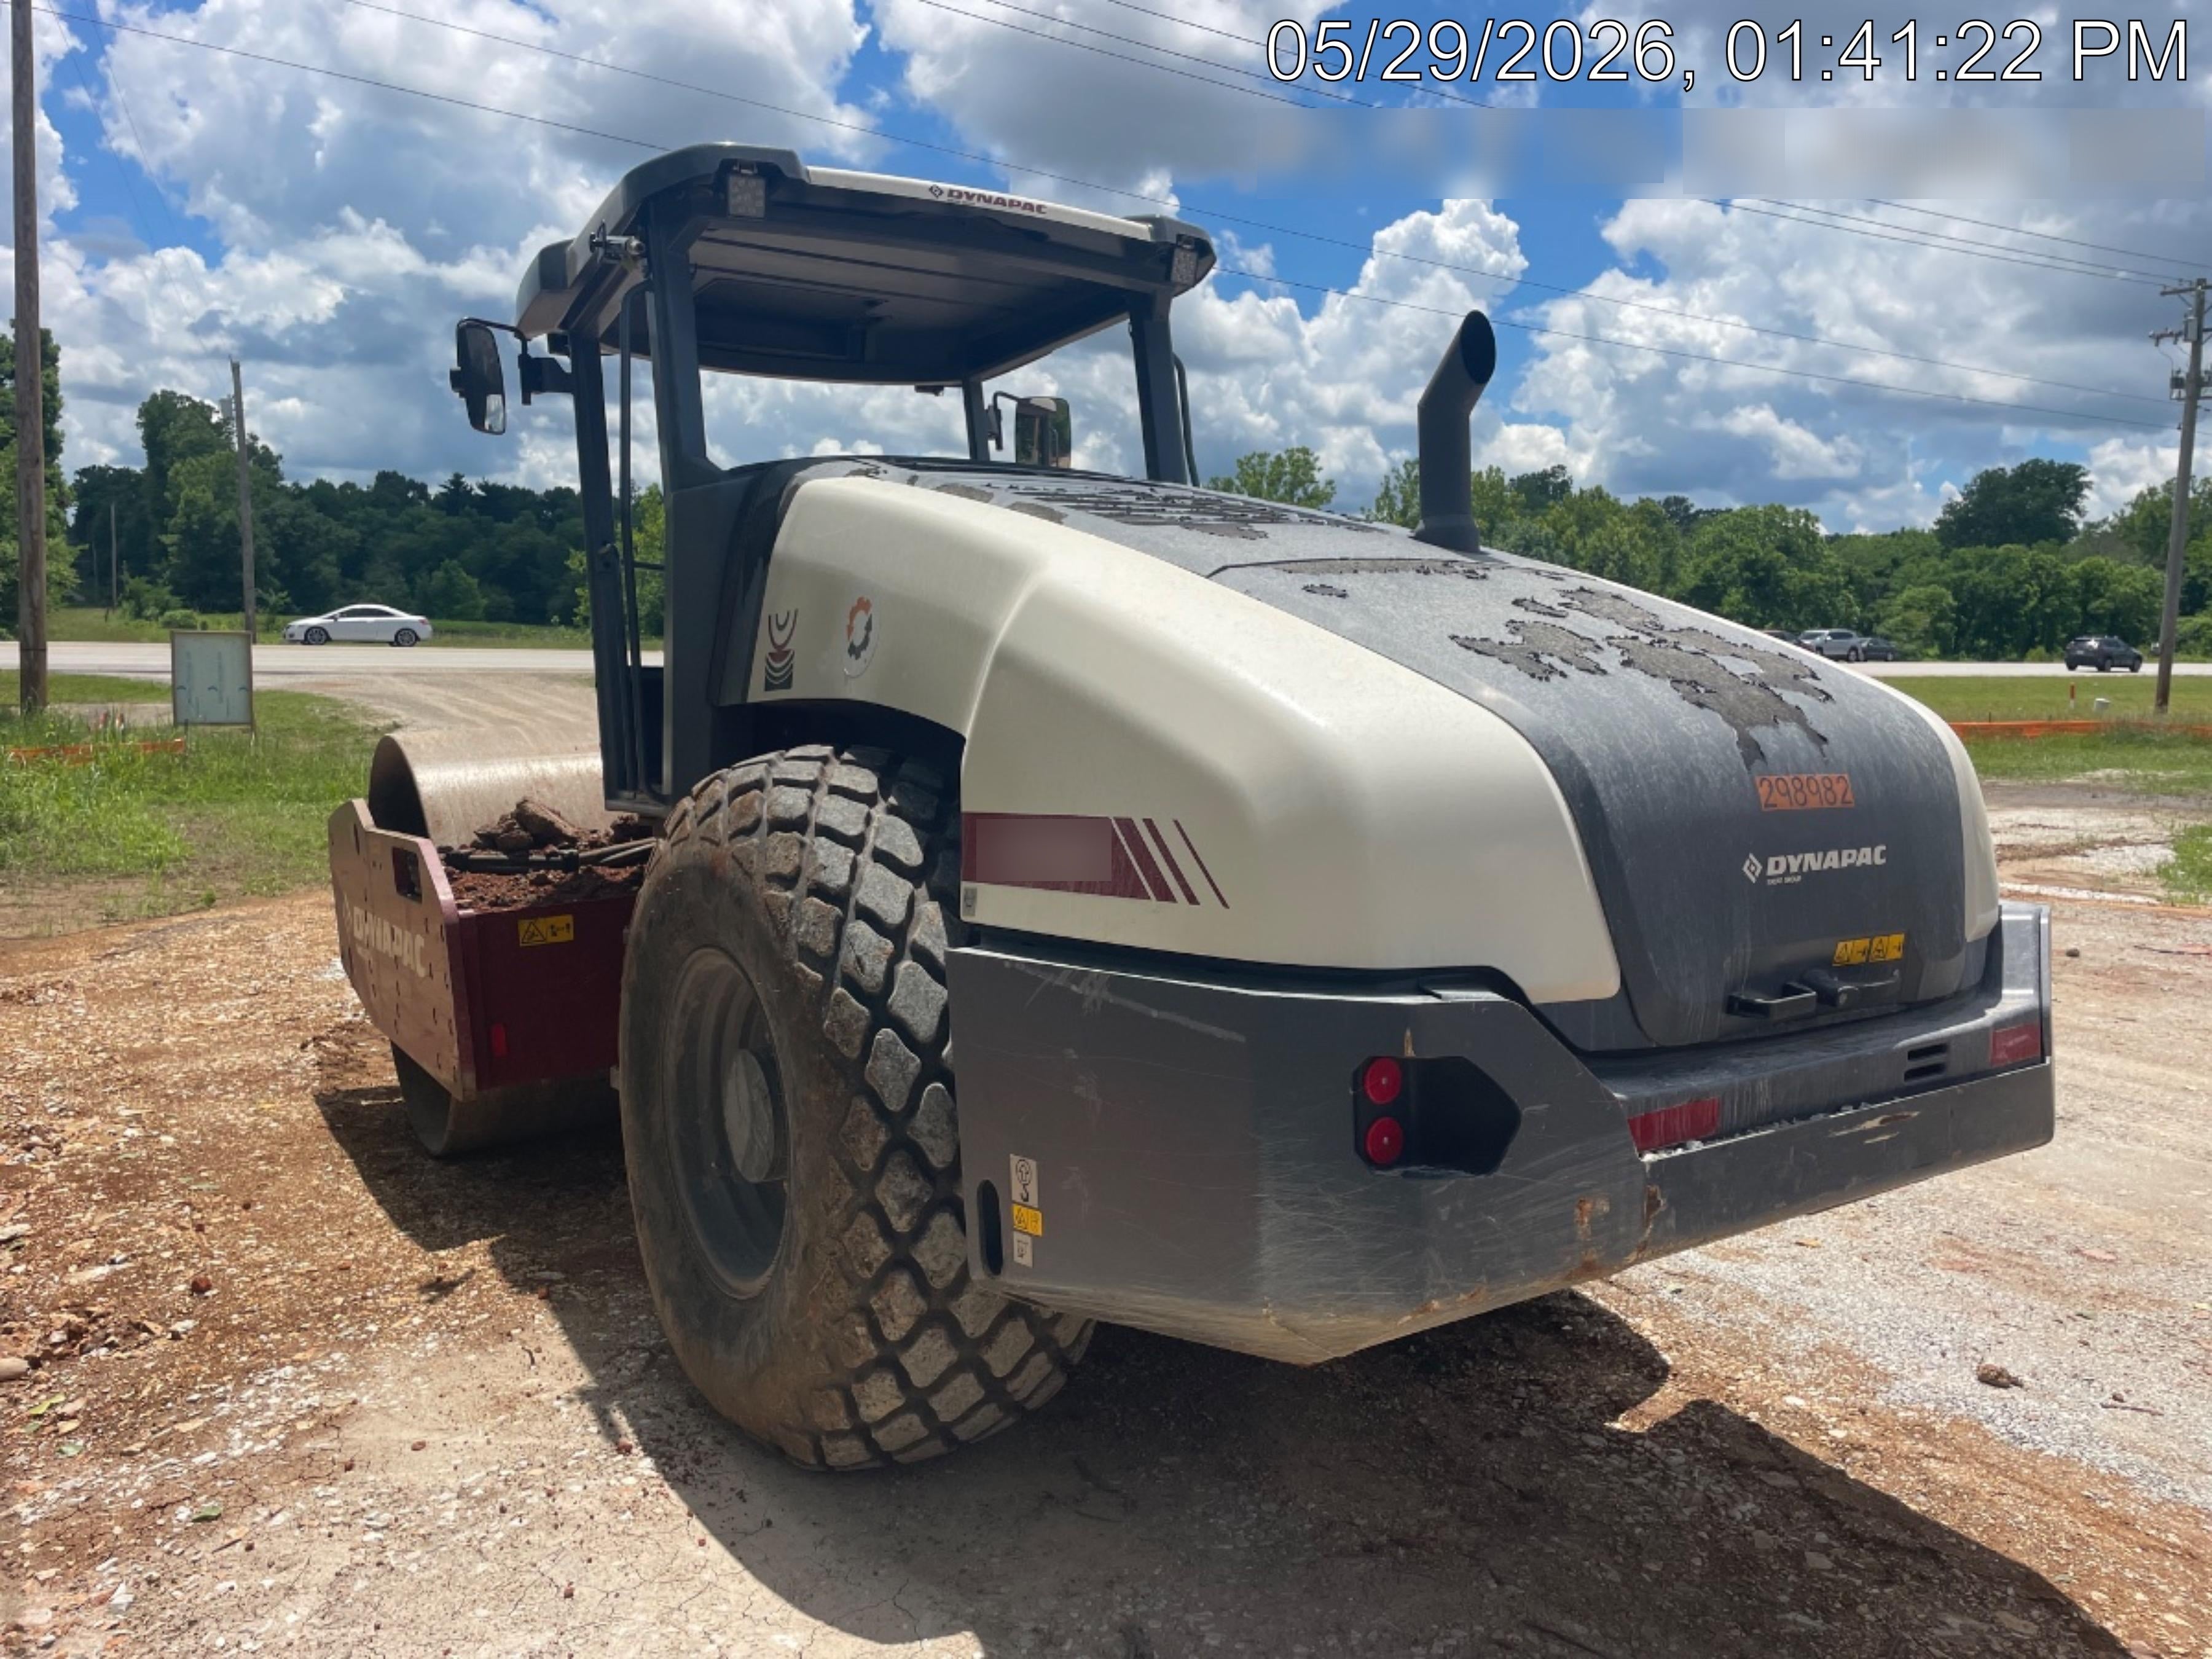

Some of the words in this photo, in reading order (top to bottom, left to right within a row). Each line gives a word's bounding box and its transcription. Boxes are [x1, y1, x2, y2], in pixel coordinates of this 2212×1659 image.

[947, 189, 1047, 213] DYNAPAC
[1759, 775, 1854, 807] 298982
[1767, 845, 1887, 876] DYNAPAC
